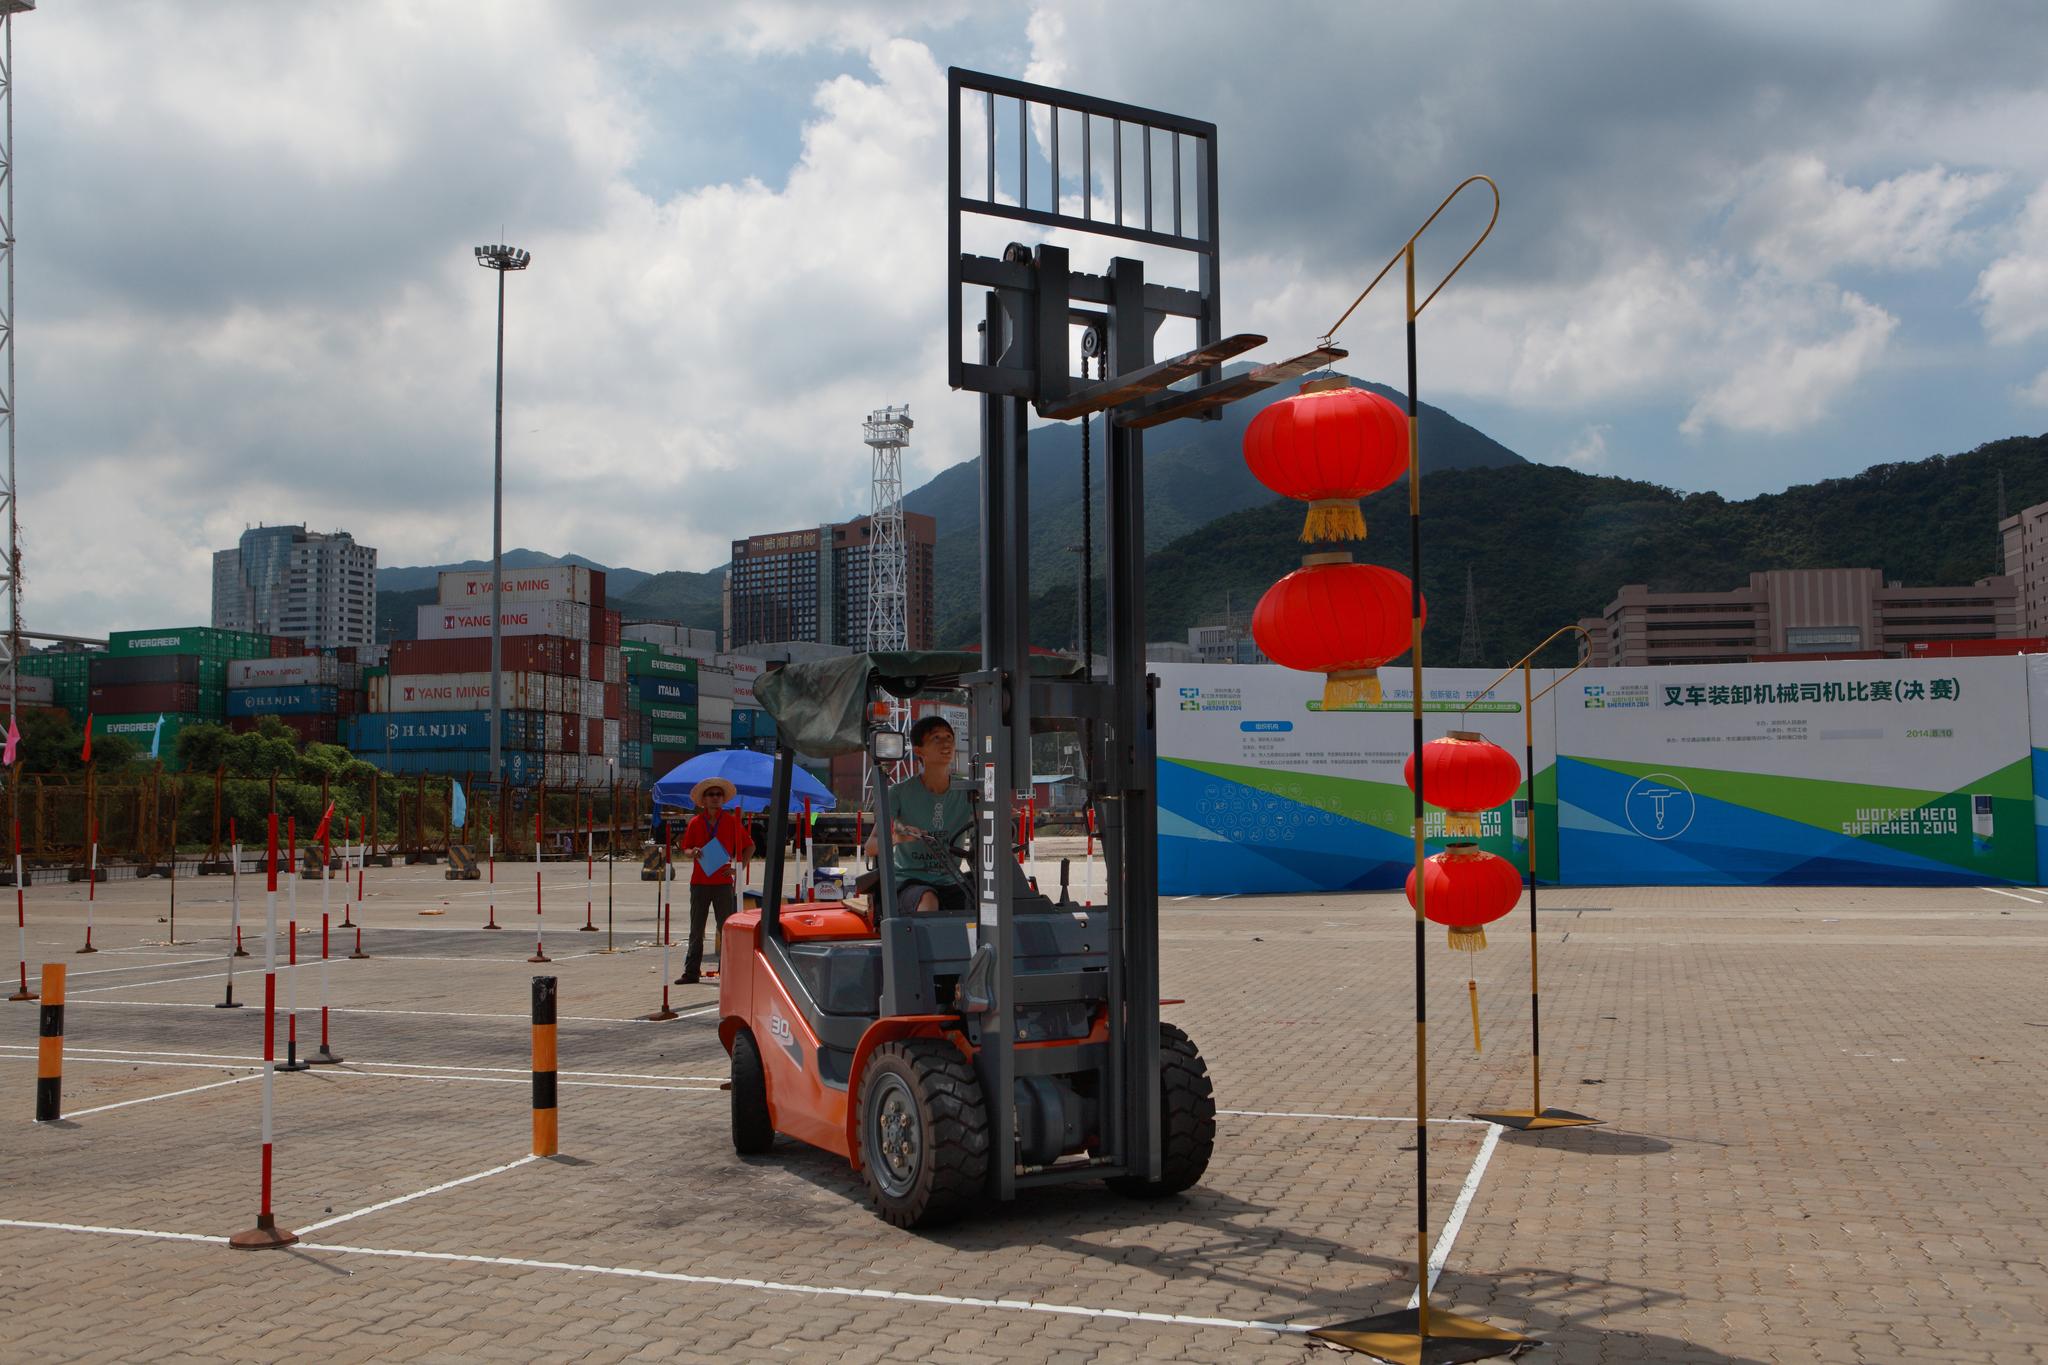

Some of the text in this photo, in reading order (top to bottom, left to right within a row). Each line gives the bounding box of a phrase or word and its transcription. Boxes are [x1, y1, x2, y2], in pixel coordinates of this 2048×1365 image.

[480, 582, 513, 593] YAG
[517, 579, 550, 591] MING
[458, 616, 491, 627] YANG
[128, 637, 180, 648] EVERGREEN
[651, 660, 686, 673] EVERGREEN
[418, 687, 452, 699] YANG
[456, 686, 490, 698] MING
[658, 685, 681, 697] ITALIA
[256, 695, 300, 706] HANJIN
[652, 709, 687, 720] EVERGREEN
[402, 723, 467, 738] HANJIN
[652, 733, 687, 744] EVERGREEN
[1480, 811, 1501, 824] ERO
[1477, 824, 1501, 837] 014
[1923, 821, 1958, 835] 2014
[983, 811, 995, 899] HELI
[771, 1015, 790, 1038] 30
